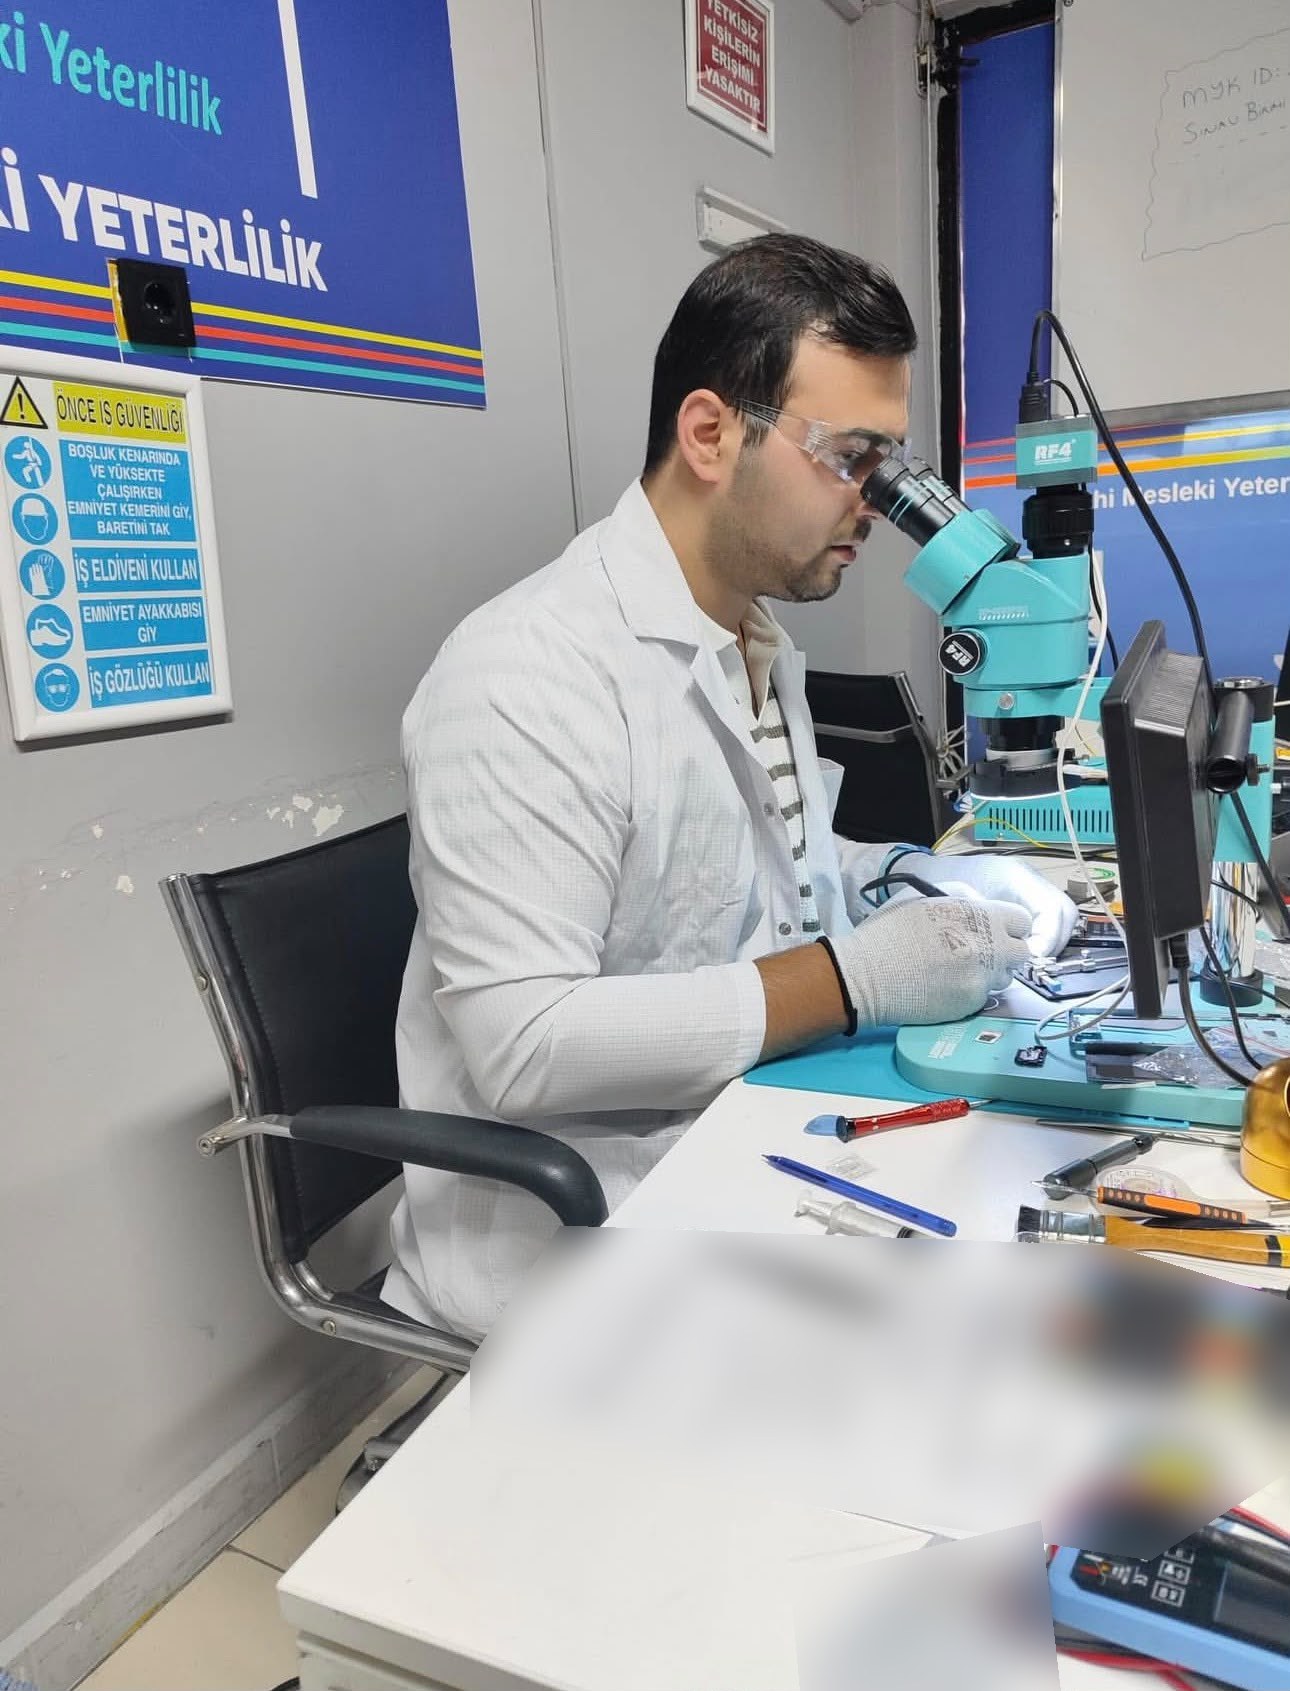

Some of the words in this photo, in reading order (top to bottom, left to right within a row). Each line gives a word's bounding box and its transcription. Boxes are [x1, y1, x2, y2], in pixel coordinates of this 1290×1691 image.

[707, 0, 758, 43] YETKİSİZ
[704, 15, 760, 68] KİŞİLERİN
[40, 22, 222, 135] Yeterlilik
[705, 64, 760, 113] YASAKTIR
[38, 173, 328, 292] YETERLİLİK
[56, 389, 97, 423] ÖNCE
[68, 443, 116, 462] BOŞLUK
[119, 448, 180, 466] KENARINDA
[90, 465, 106, 478] VE
[108, 463, 166, 482] YÜKSEKTE
[68, 500, 118, 516] EMNİYET
[120, 503, 170, 518] KEMERİNİ
[97, 484, 162, 501] ÇALIŞIRKEN
[97, 519, 148, 535] BARETİNİ
[150, 521, 170, 536] TAK
[75, 553, 88, 588] İŞ
[92, 552, 149, 582] ELDİVENİ
[151, 559, 197, 581] KULLAN
[83, 602, 135, 623] EMNİYET
[138, 602, 202, 621] AYAKKABISI
[138, 623, 157, 643] GİY
[89, 666, 103, 701] İŞ
[105, 661, 162, 695] GÖZLÜĞÜ
[165, 663, 210, 688] KULLAN
